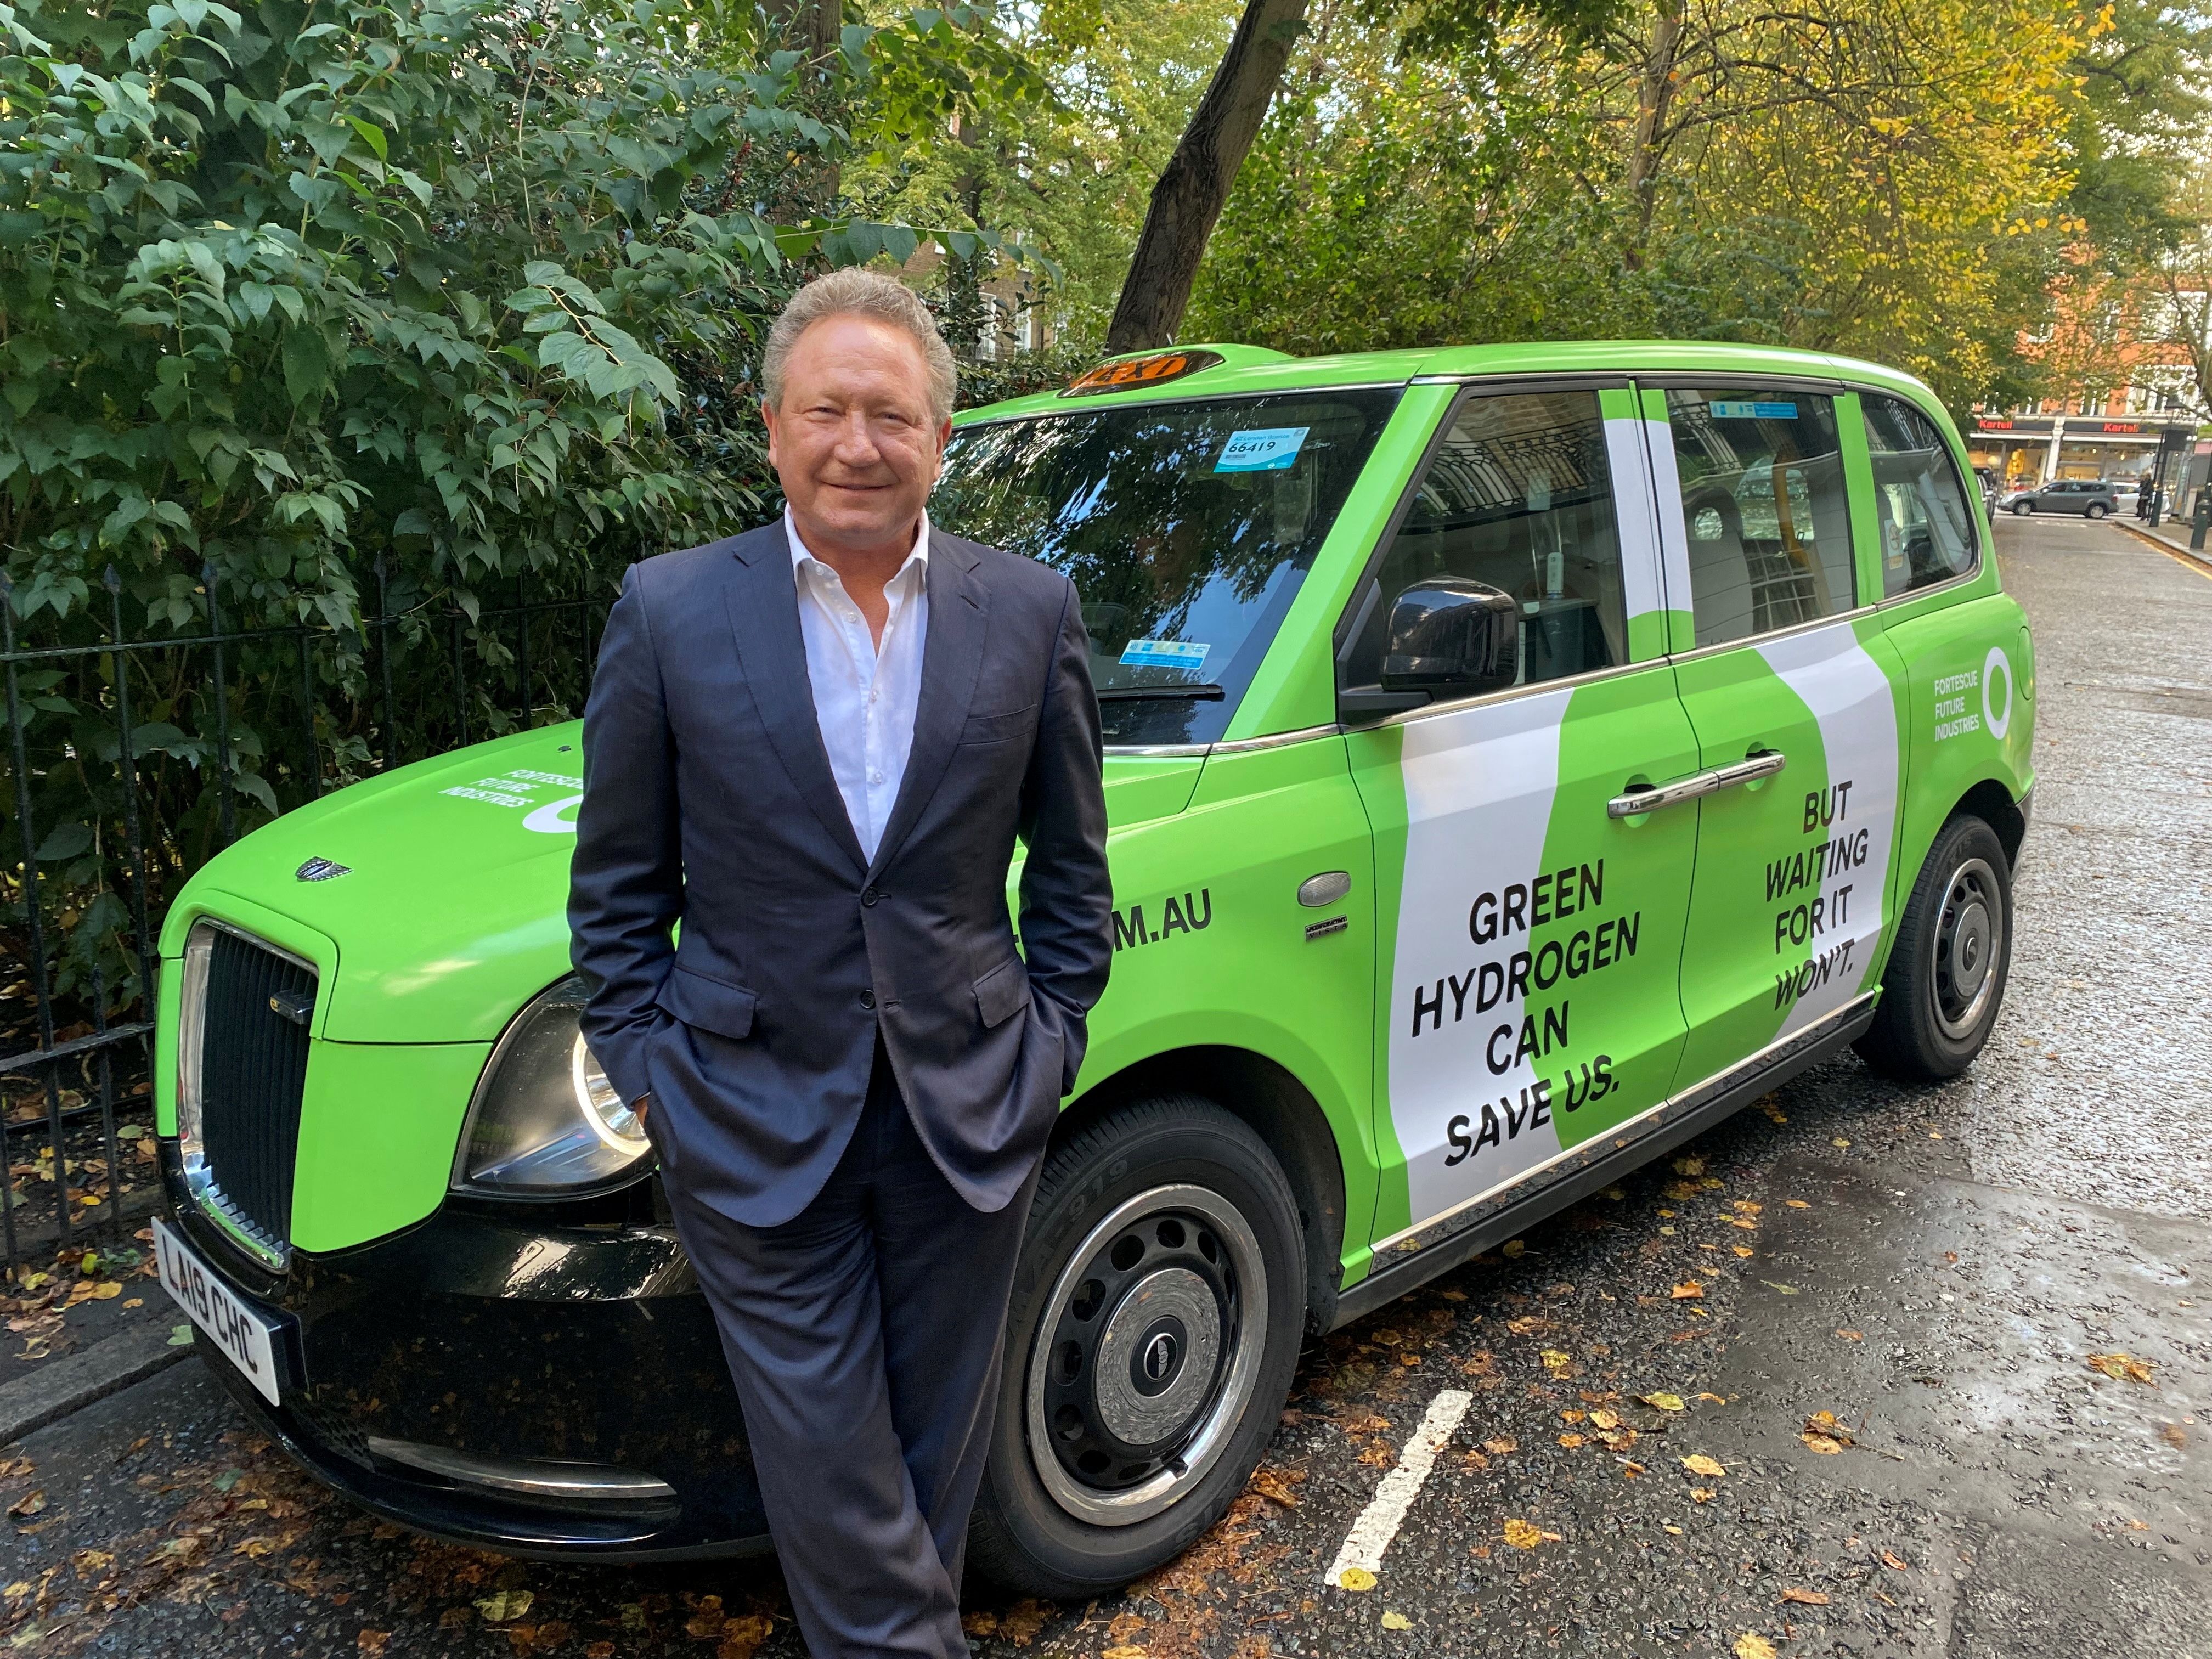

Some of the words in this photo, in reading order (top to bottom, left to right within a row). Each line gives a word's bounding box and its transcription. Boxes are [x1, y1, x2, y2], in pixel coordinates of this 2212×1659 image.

[1228, 442, 1276, 453] 66419
[1934, 670, 1978, 696] FORTESCUE
[1936, 696, 1965, 720] FUTURE
[1935, 714, 1979, 742] INDUSTRIES
[437, 786, 534, 808] INDUSTRIES
[469, 778, 540, 793] FUTURE
[501, 769, 583, 789] FORTESCU
[1803, 780, 1853, 834] BUT
[1766, 828, 1869, 902] WAITING
[1469, 859, 1604, 945] GREEN
[1775, 897, 1825, 955] FOR
[1831, 884, 1853, 929] IT
[1309, 923, 1347, 938] VISTA
[1412, 911, 1640, 1038] HYDROGEN
[1774, 938, 1855, 1011] WON'T.
[1486, 1000, 1569, 1076] CAN
[1444, 1079, 1552, 1167] SAVE
[1564, 1054, 1621, 1113] US.
[162, 1234, 210, 1323] LA19
[211, 1285, 258, 1374] CHC
